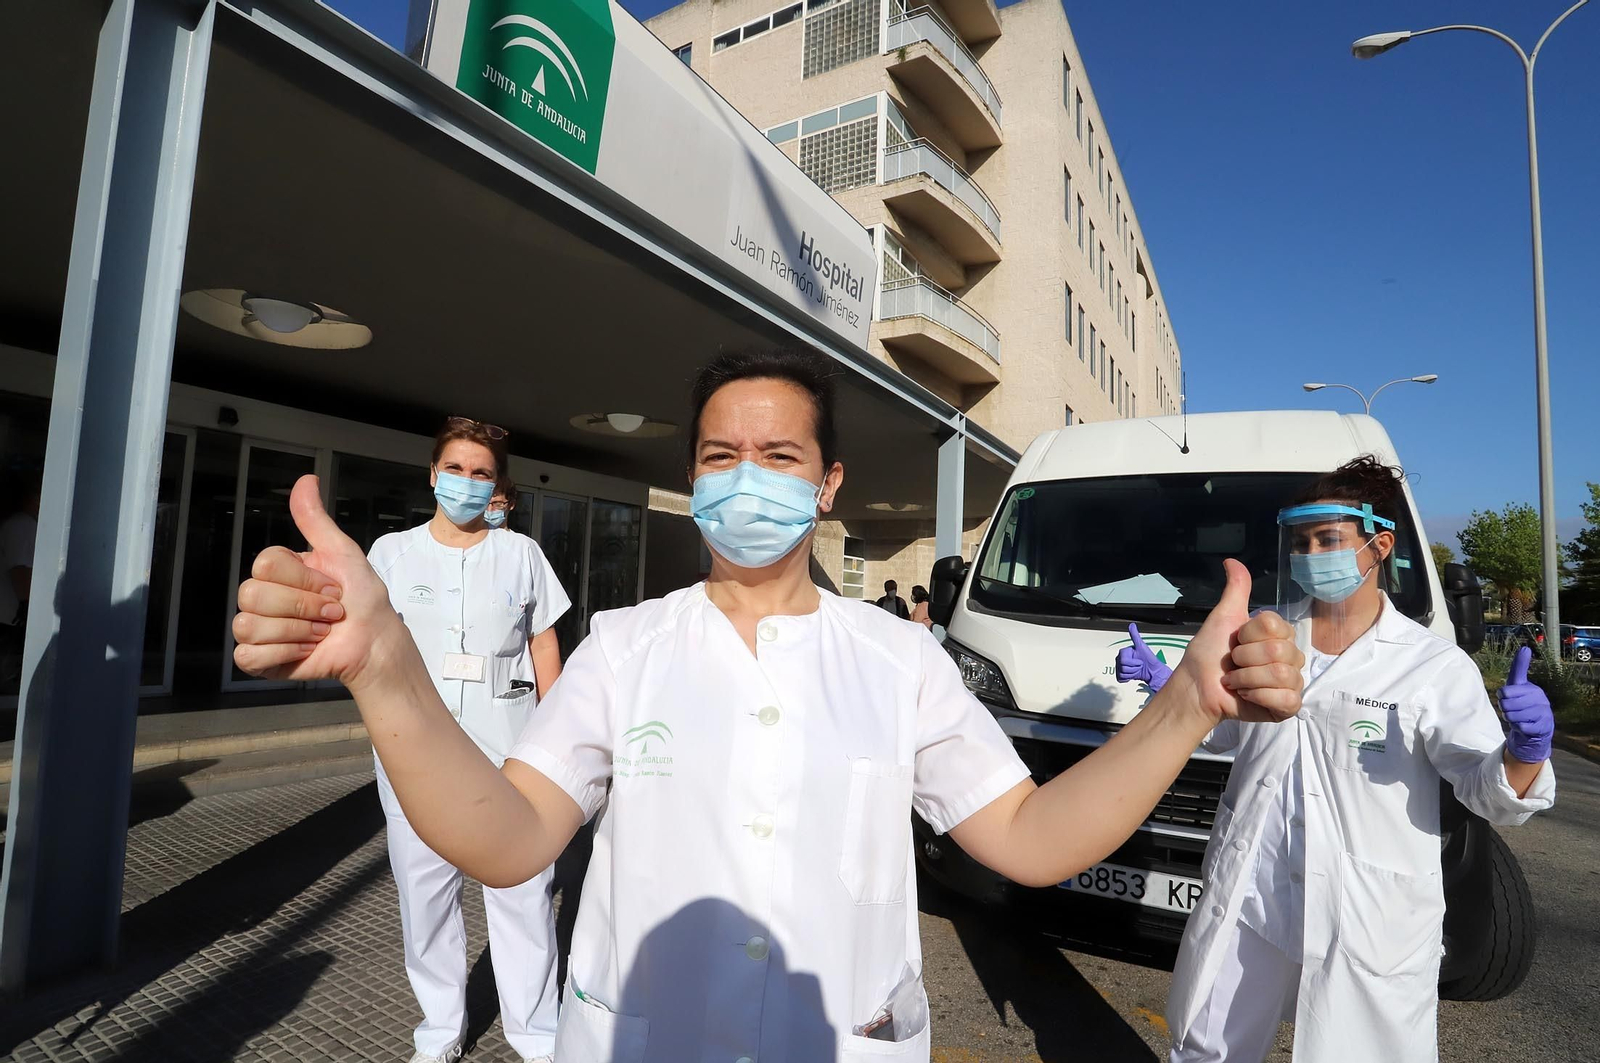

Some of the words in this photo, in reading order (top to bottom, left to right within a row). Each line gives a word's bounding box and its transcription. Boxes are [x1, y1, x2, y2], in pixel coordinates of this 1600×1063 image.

[482, 64, 516, 97] JUNTA
[521, 88, 534, 108] DE
[536, 99, 586, 144] ANDALUCIA
[730, 225, 765, 264] Juan
[770, 250, 814, 297] Ramón
[816, 285, 860, 329] Jiménez
[799, 230, 864, 302] Hospital
[1355, 697, 1397, 711] MÉDICO
[1078, 866, 1146, 900] 6853
